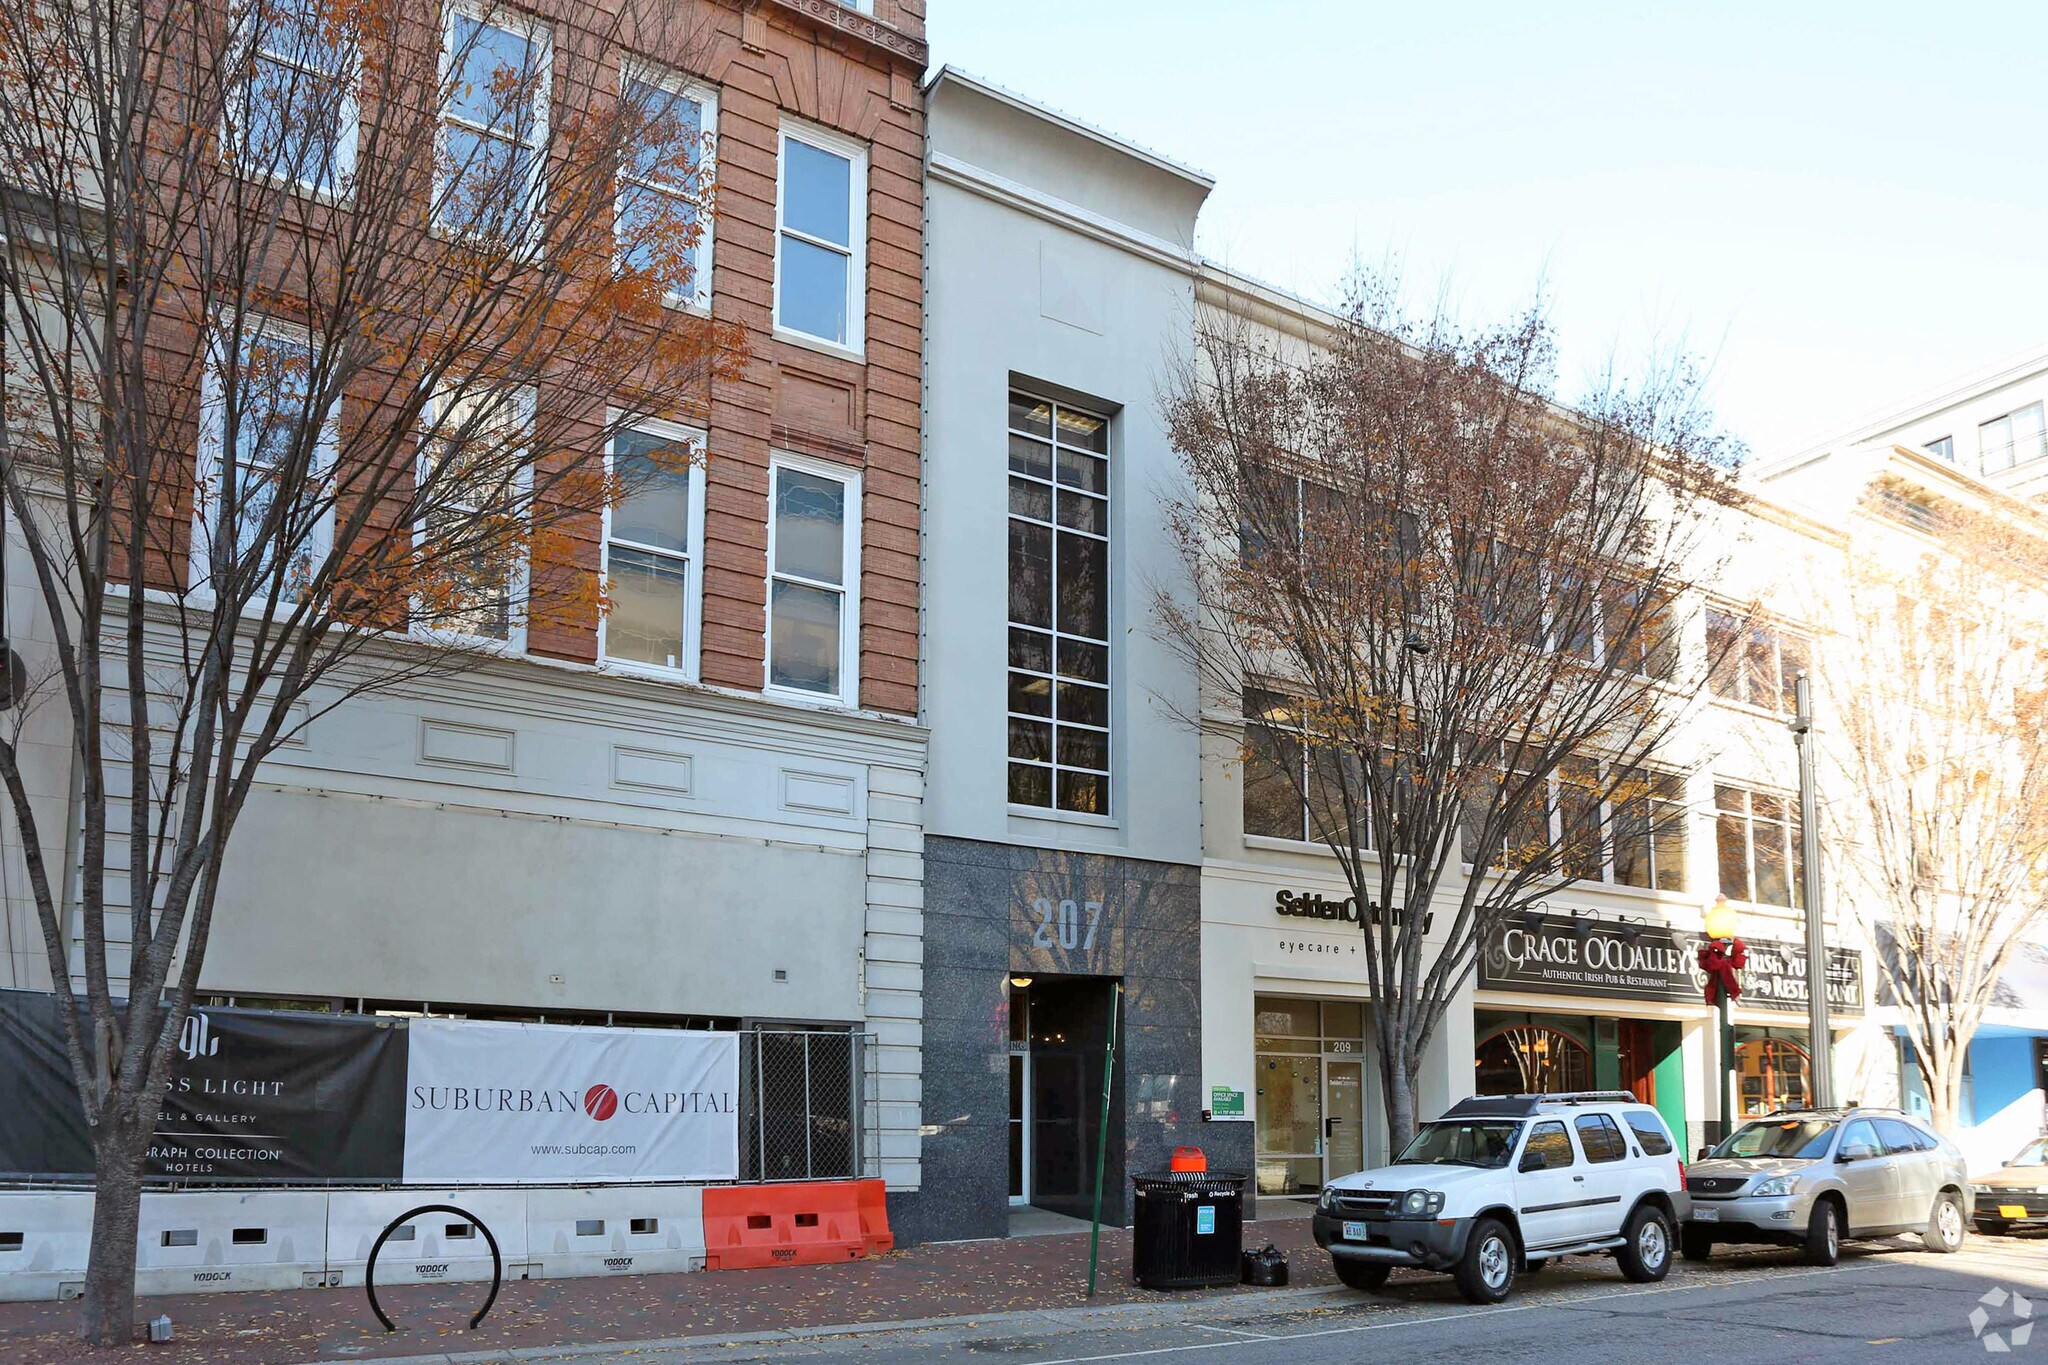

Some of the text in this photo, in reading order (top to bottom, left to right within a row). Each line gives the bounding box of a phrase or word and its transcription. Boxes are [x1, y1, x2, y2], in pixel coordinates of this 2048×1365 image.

[1033, 899, 1102, 950] 207
[1279, 941, 1339, 954] eyecare
[1503, 929, 1578, 971] GRACE
[1542, 969, 1668, 988] AUTHENTIC IRISH PUB & RESTAURANT
[1333, 1041, 1351, 1053] 209
[204, 1078, 284, 1096] LIGHT
[411, 1085, 736, 1114] SUBURBAN CAPITAL
[180, 1113, 188, 1121] &
[195, 1114, 257, 1123] GALLERY
[530, 1142, 637, 1157] www.subcap.com
[166, 1163, 213, 1173] HOTELS
[603, 1257, 634, 1266] YODOCK
[415, 1264, 450, 1273] YODOCK
[193, 1271, 232, 1282] YODOCK
